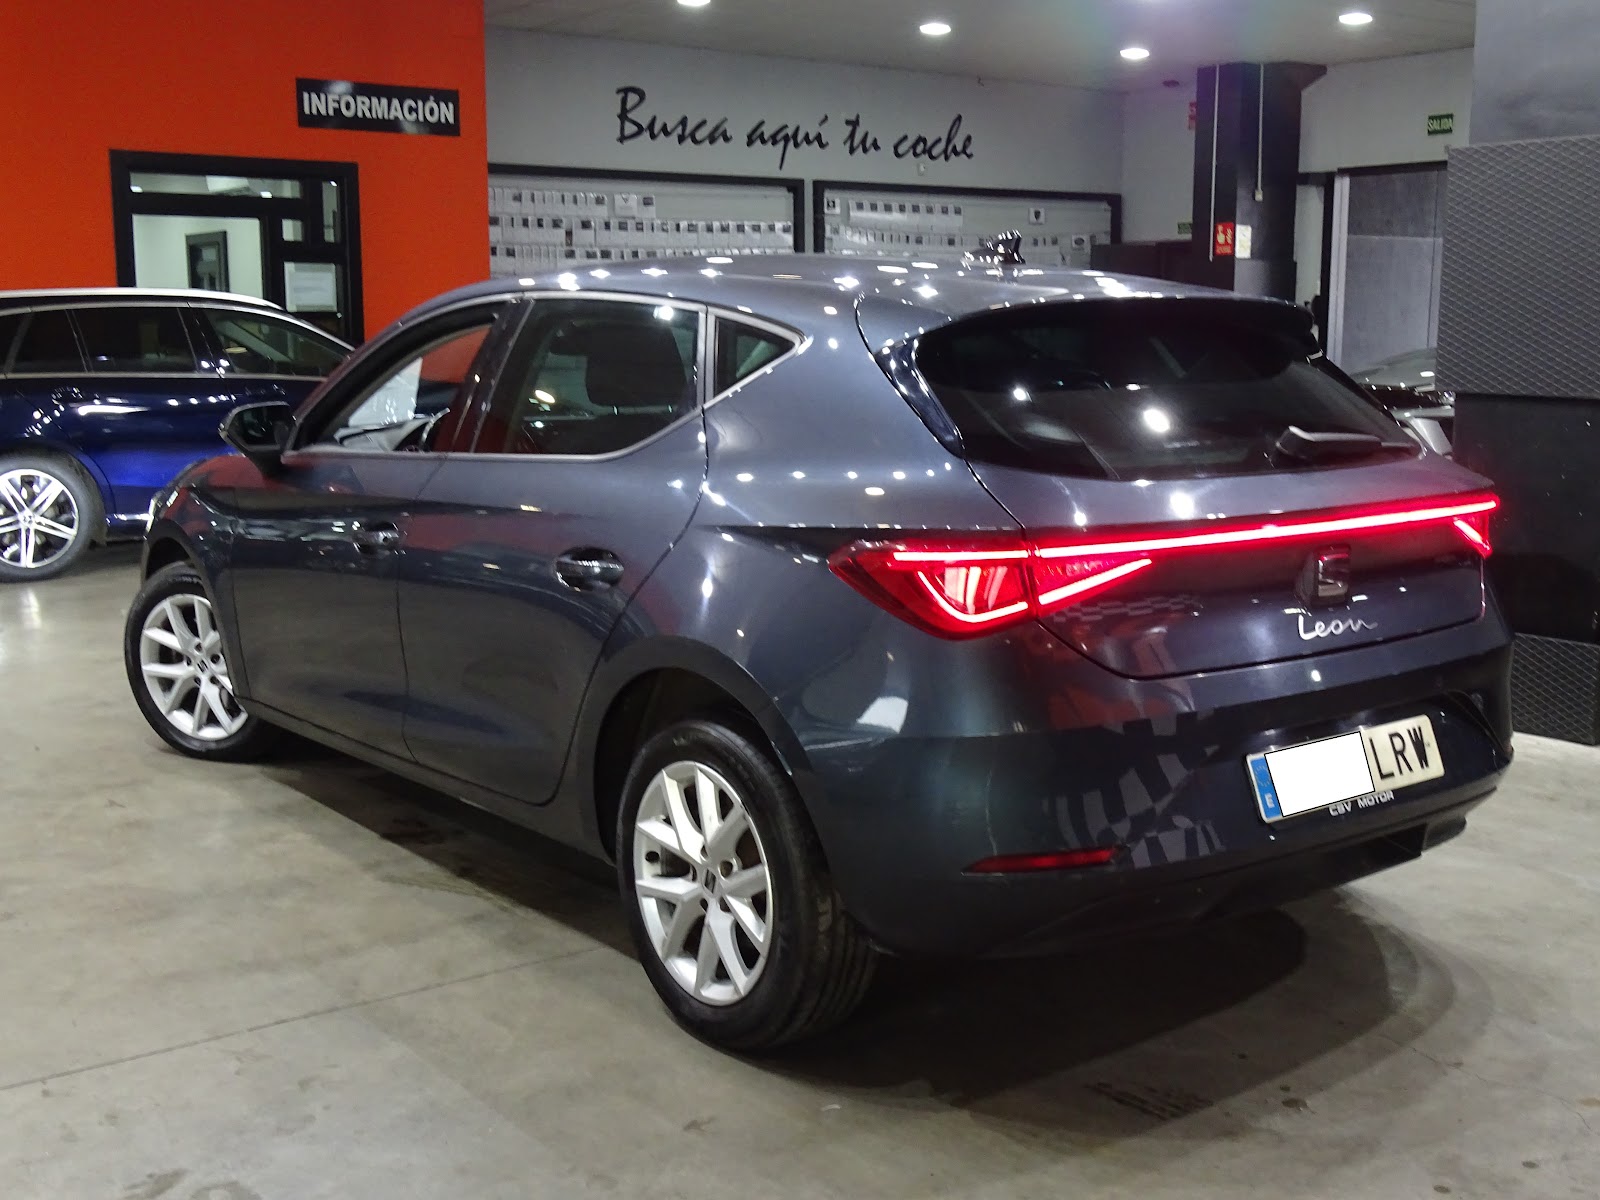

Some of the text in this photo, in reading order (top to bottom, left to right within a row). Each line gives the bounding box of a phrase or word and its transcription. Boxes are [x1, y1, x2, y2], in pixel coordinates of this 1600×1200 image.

[302, 91, 456, 125] INFORMACIÓN
[615, 86, 975, 171] Busca aquí tu coche
[1428, 118, 1453, 131] SALIDA
[1297, 613, 1379, 641] Leon
[1368, 725, 1430, 781] LRW
[1264, 793, 1275, 810] E
[1356, 790, 1395, 809] MOTOR
